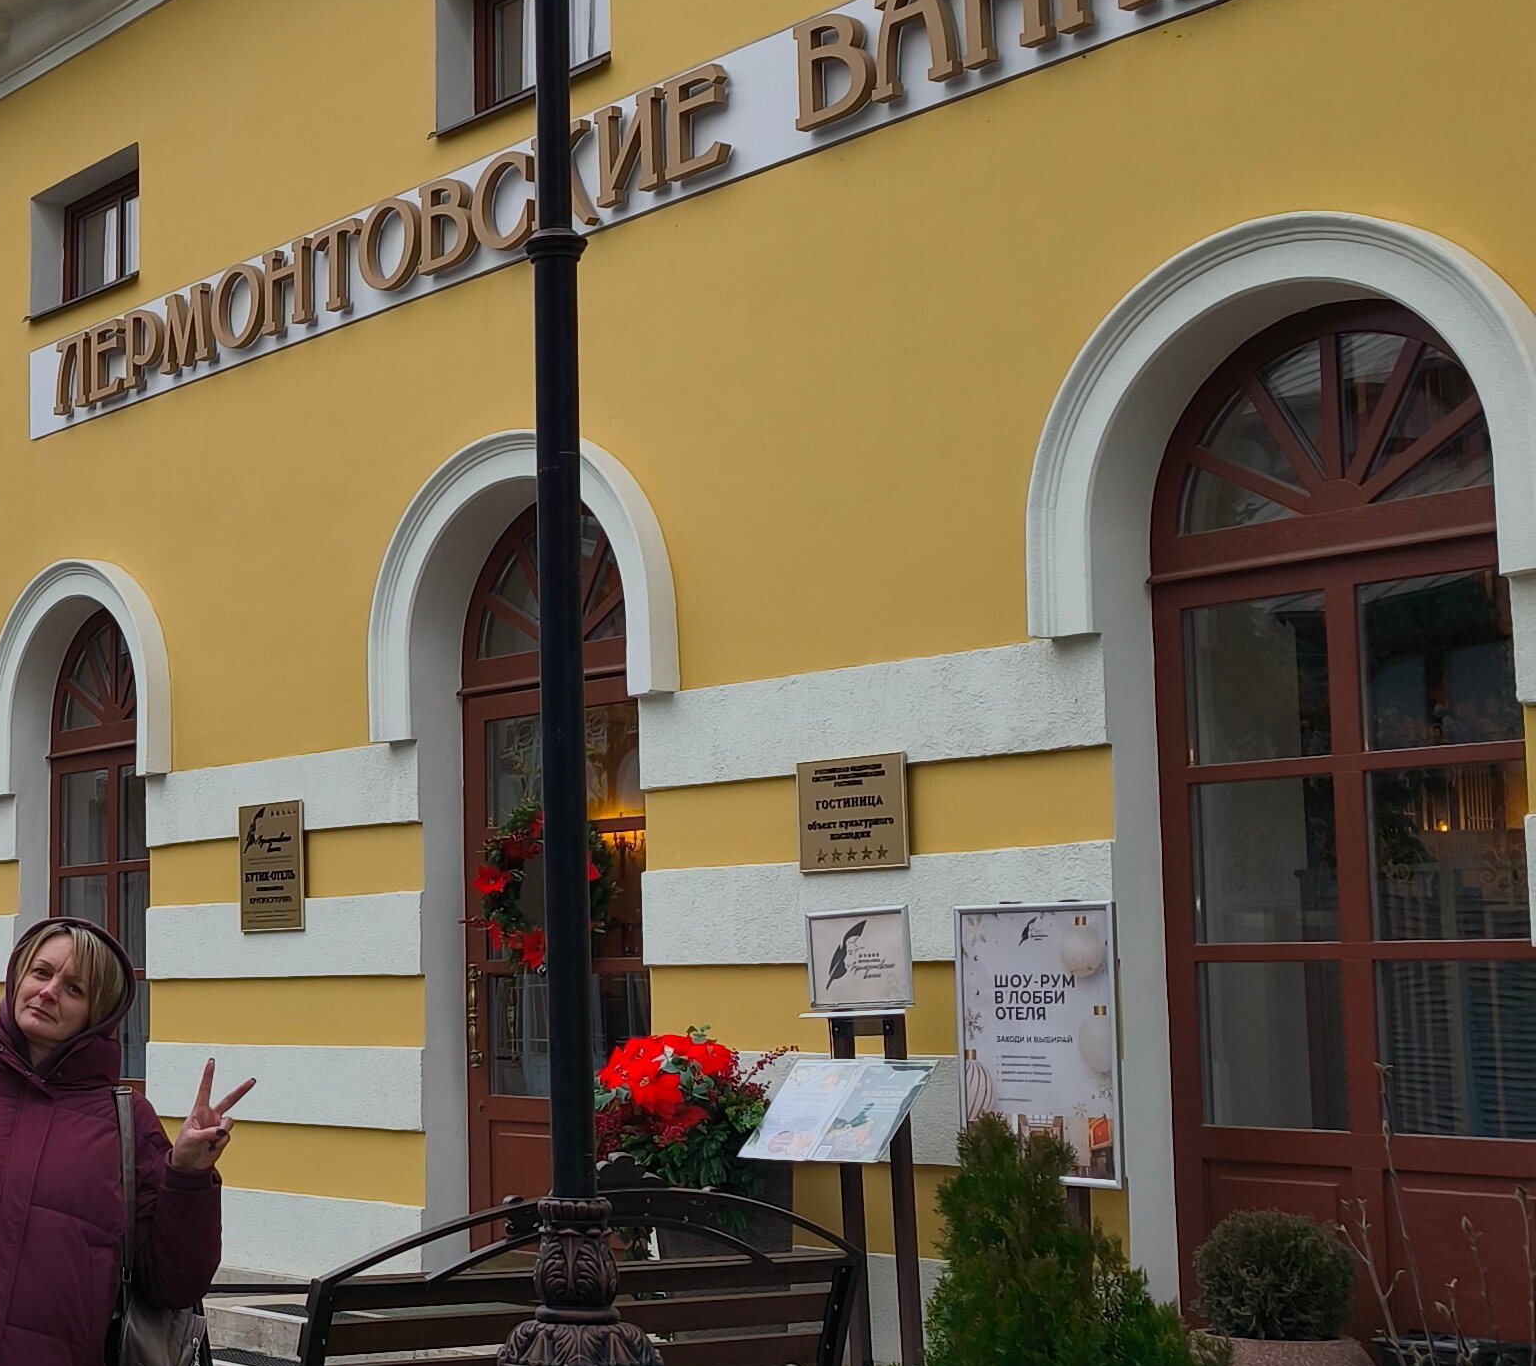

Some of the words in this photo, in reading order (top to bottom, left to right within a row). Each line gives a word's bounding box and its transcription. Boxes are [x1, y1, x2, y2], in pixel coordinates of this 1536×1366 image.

[54, 64, 732, 416] ЛЕРМОНТОВСКИЕ
[815, 795, 884, 811] ГОСТИНИЦА
[994, 973, 1076, 989] ШОУ-РУМ
[994, 990, 1005, 1005] В
[1008, 990, 1066, 1005] ЛОББИ
[995, 1006, 1047, 1021] ОТЕЛЯ
[996, 1035, 1025, 1044] ЗАХОДИ
